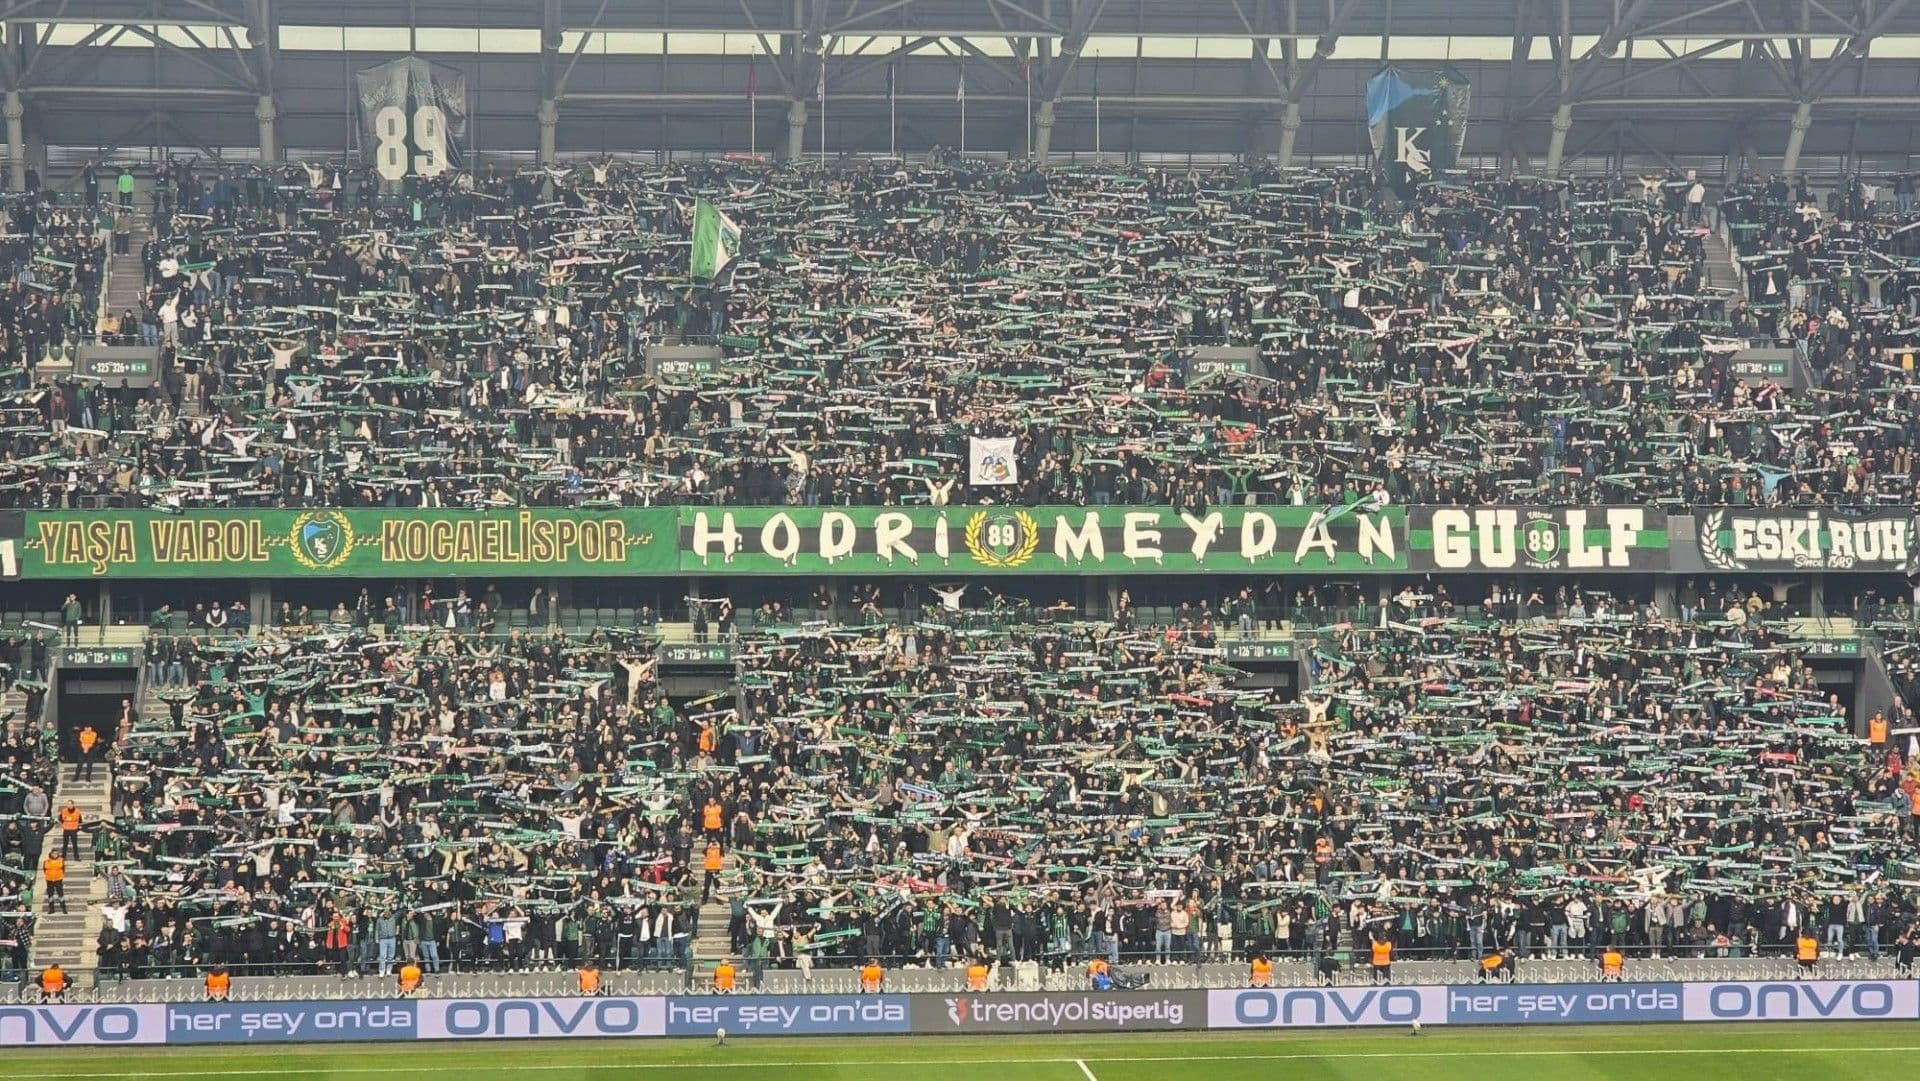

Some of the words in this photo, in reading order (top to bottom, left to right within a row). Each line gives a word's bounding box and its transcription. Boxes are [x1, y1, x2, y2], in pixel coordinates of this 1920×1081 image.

[376, 106, 447, 180] 89
[39, 520, 136, 575] YAŞA
[149, 519, 269, 562] VAROL
[382, 511, 626, 562] KOCAELİSPOR
[988, 524, 1015, 546] 89
[1044, 511, 1395, 565] MEYDAN
[1529, 529, 1555, 552] 89
[1733, 511, 1821, 559] ESKİ
[1829, 520, 1907, 560] RUH
[669, 1001, 725, 1024] her
[738, 1005, 800, 1030] şey
[971, 997, 1090, 1026] trendyol
[1450, 991, 1508, 1013] her
[1517, 994, 1577, 1018] şey
[170, 1009, 231, 1031] her
[241, 1012, 305, 1036] şey
